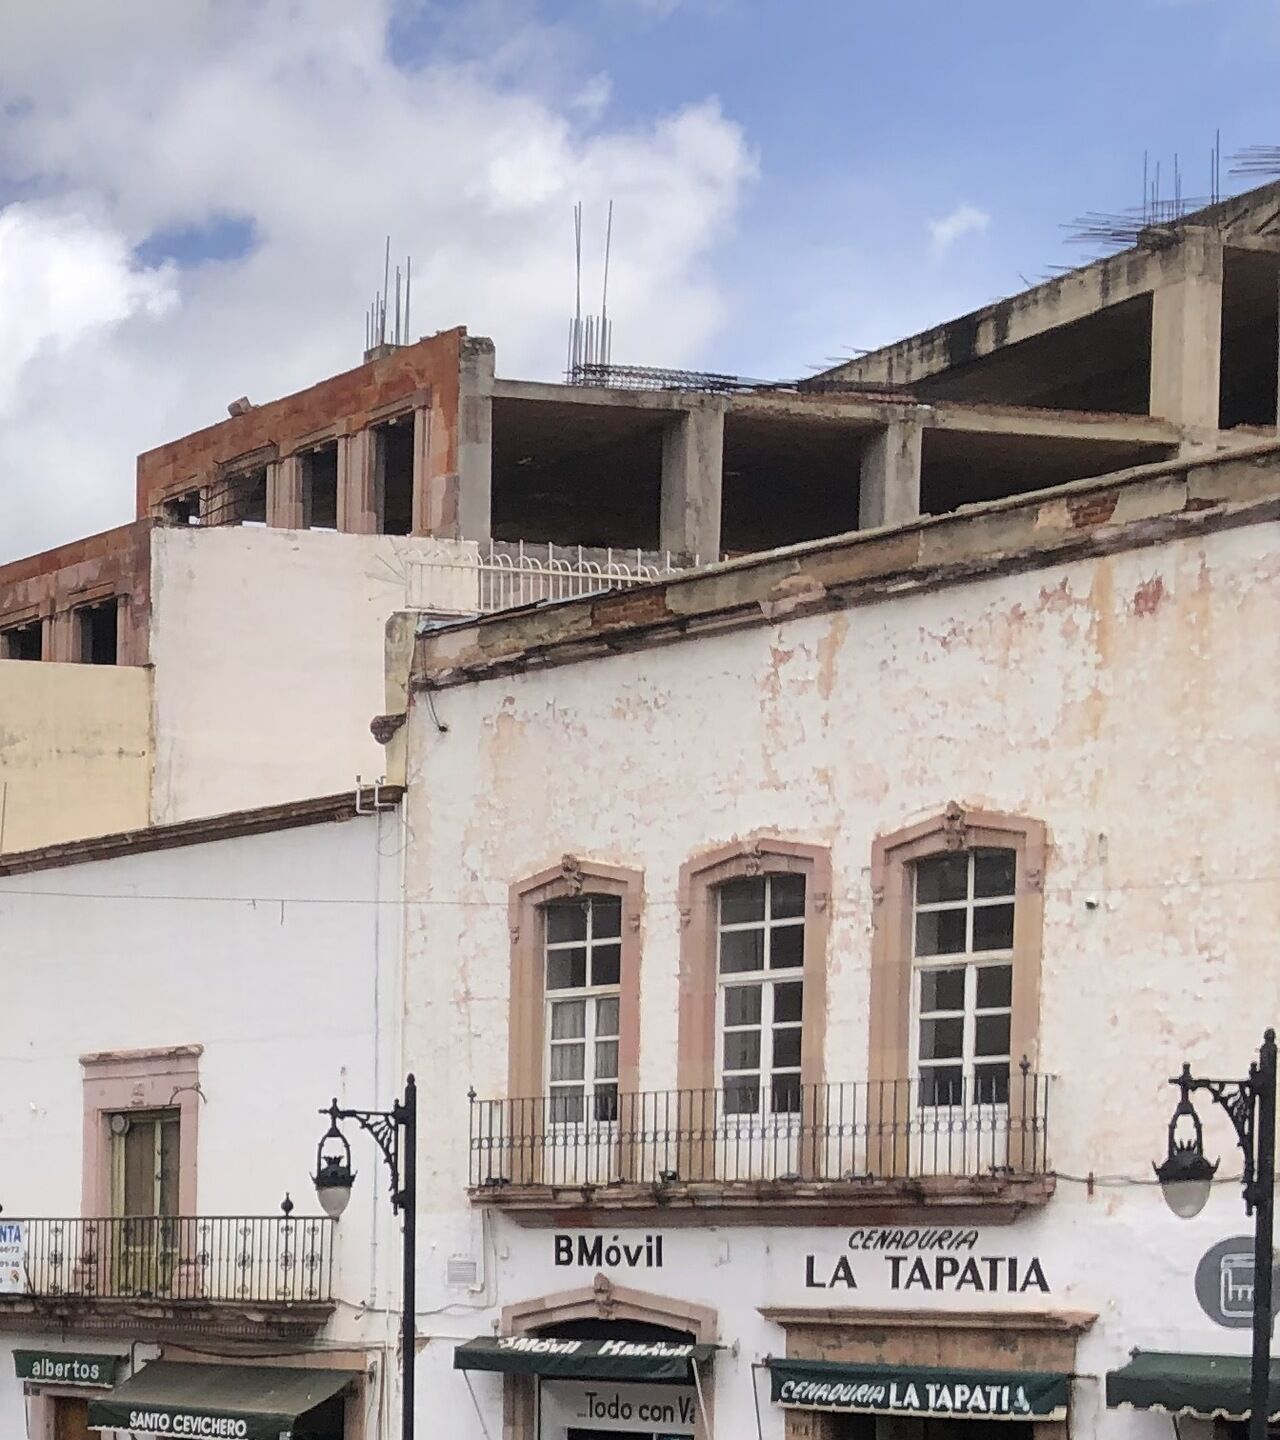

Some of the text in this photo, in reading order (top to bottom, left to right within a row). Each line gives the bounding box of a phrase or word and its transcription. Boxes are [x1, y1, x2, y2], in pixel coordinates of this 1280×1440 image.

[554, 1235, 663, 1269] BMóvil
[848, 1229, 980, 1251] CENADURIA
[806, 1255, 1051, 1294] LA TAPATIA
[32, 1359, 100, 1380] albertos
[781, 1380, 1031, 1411] CENADURIA LA TAPATIA
[129, 1411, 247, 1437] SANTO CEVICHERO
[639, 1403, 674, 1423] con
